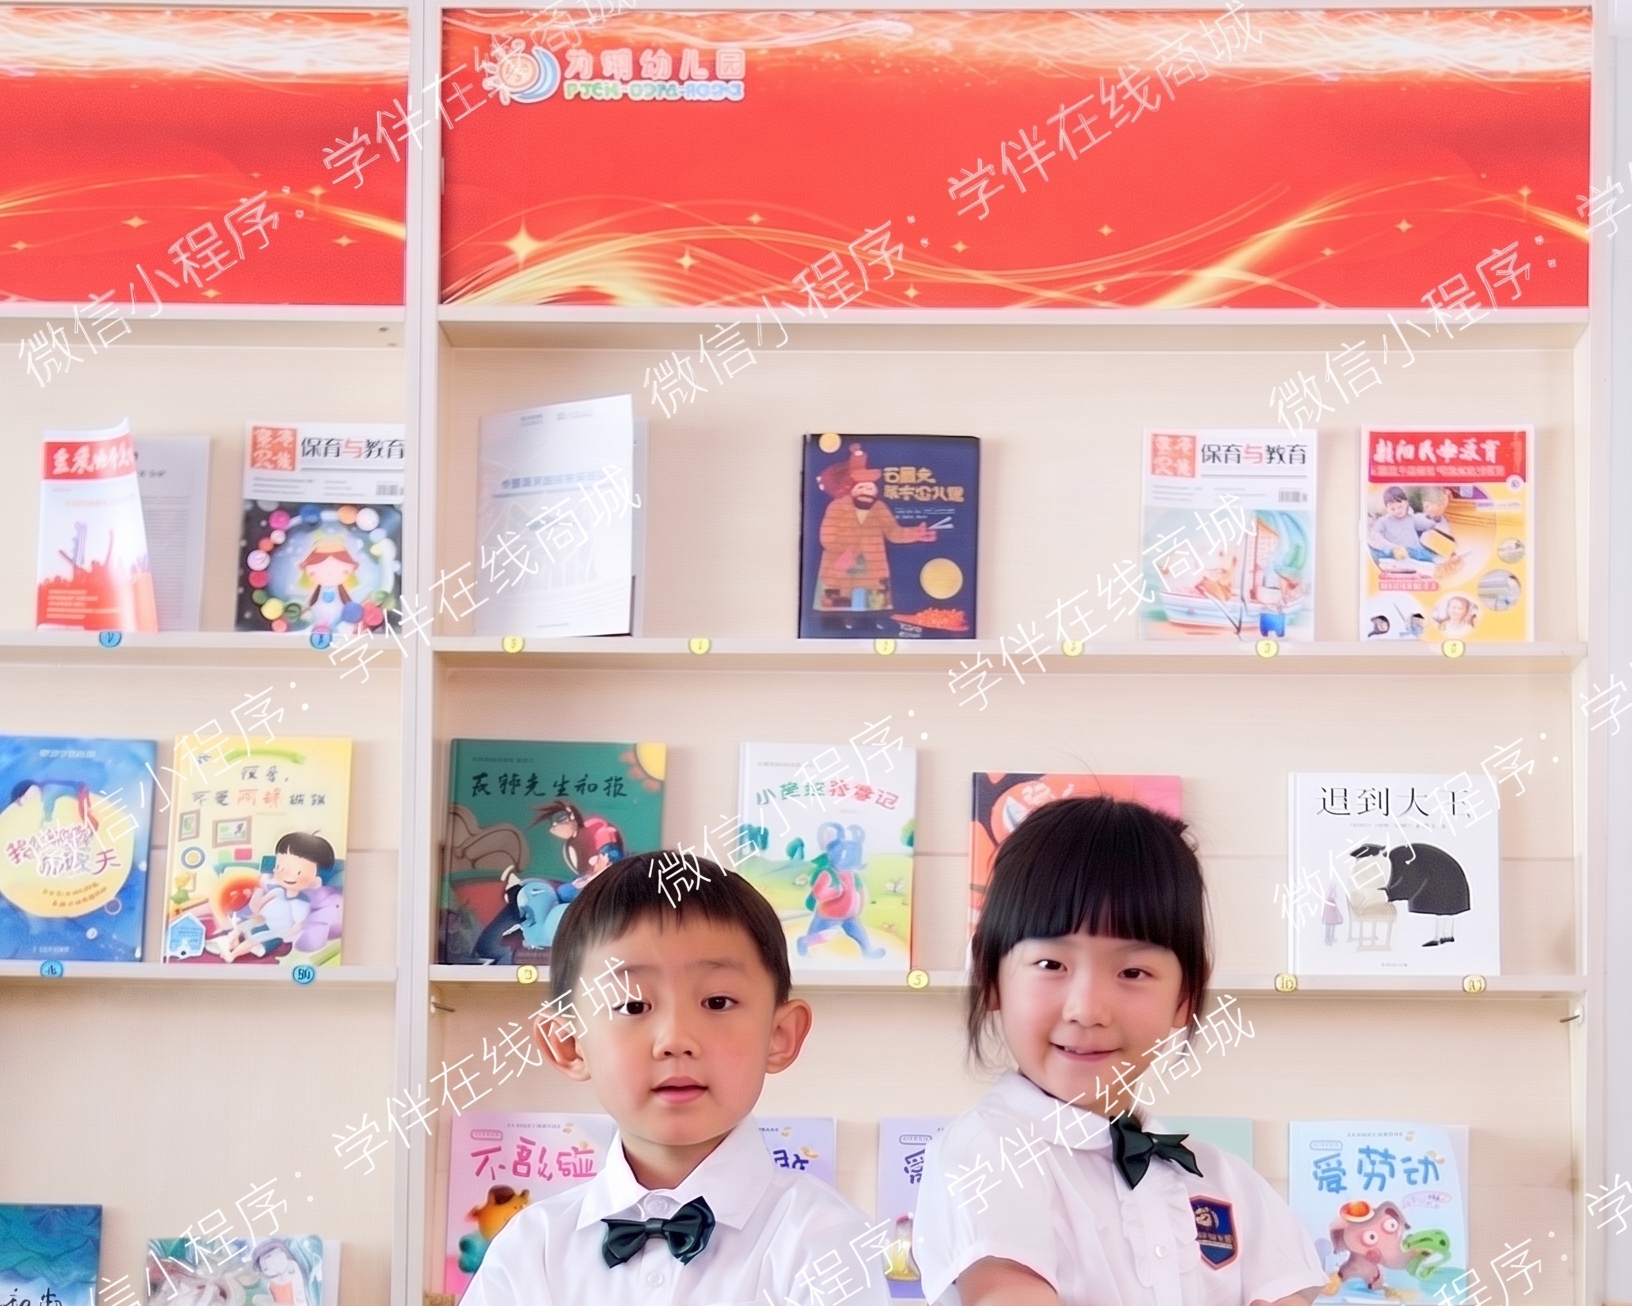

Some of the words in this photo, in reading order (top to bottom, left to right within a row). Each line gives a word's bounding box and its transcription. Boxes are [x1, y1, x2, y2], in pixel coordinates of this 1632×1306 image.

[301, 437, 405, 459] 保育与教育
[1201, 443, 1308, 465] 保育与教育
[1312, 1145, 1440, 1194] 爱劳动
